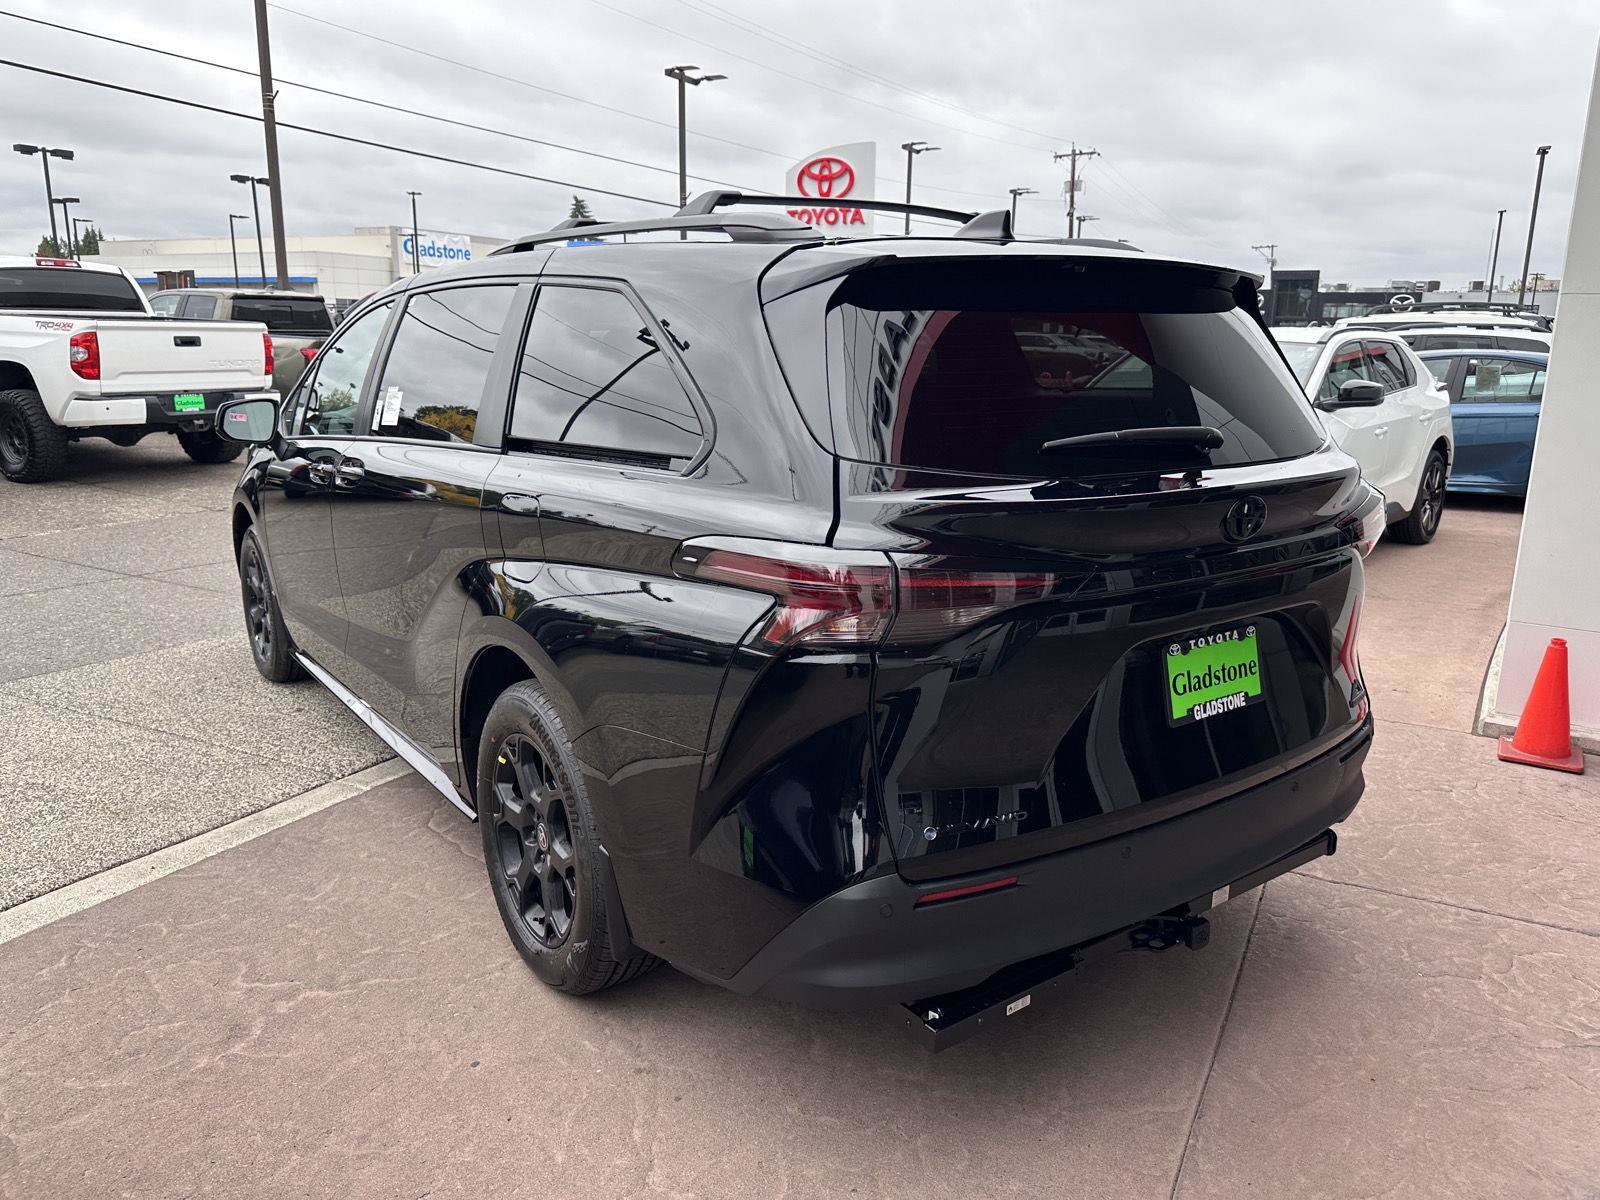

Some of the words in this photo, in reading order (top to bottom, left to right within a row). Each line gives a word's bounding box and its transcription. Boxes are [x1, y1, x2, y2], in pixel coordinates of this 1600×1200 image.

[403, 238, 471, 261] Gadstone
[1189, 629, 1239, 650] TOYOTA
[1172, 659, 1257, 697] Gladstone
[1193, 691, 1247, 721] GLADSTONE
